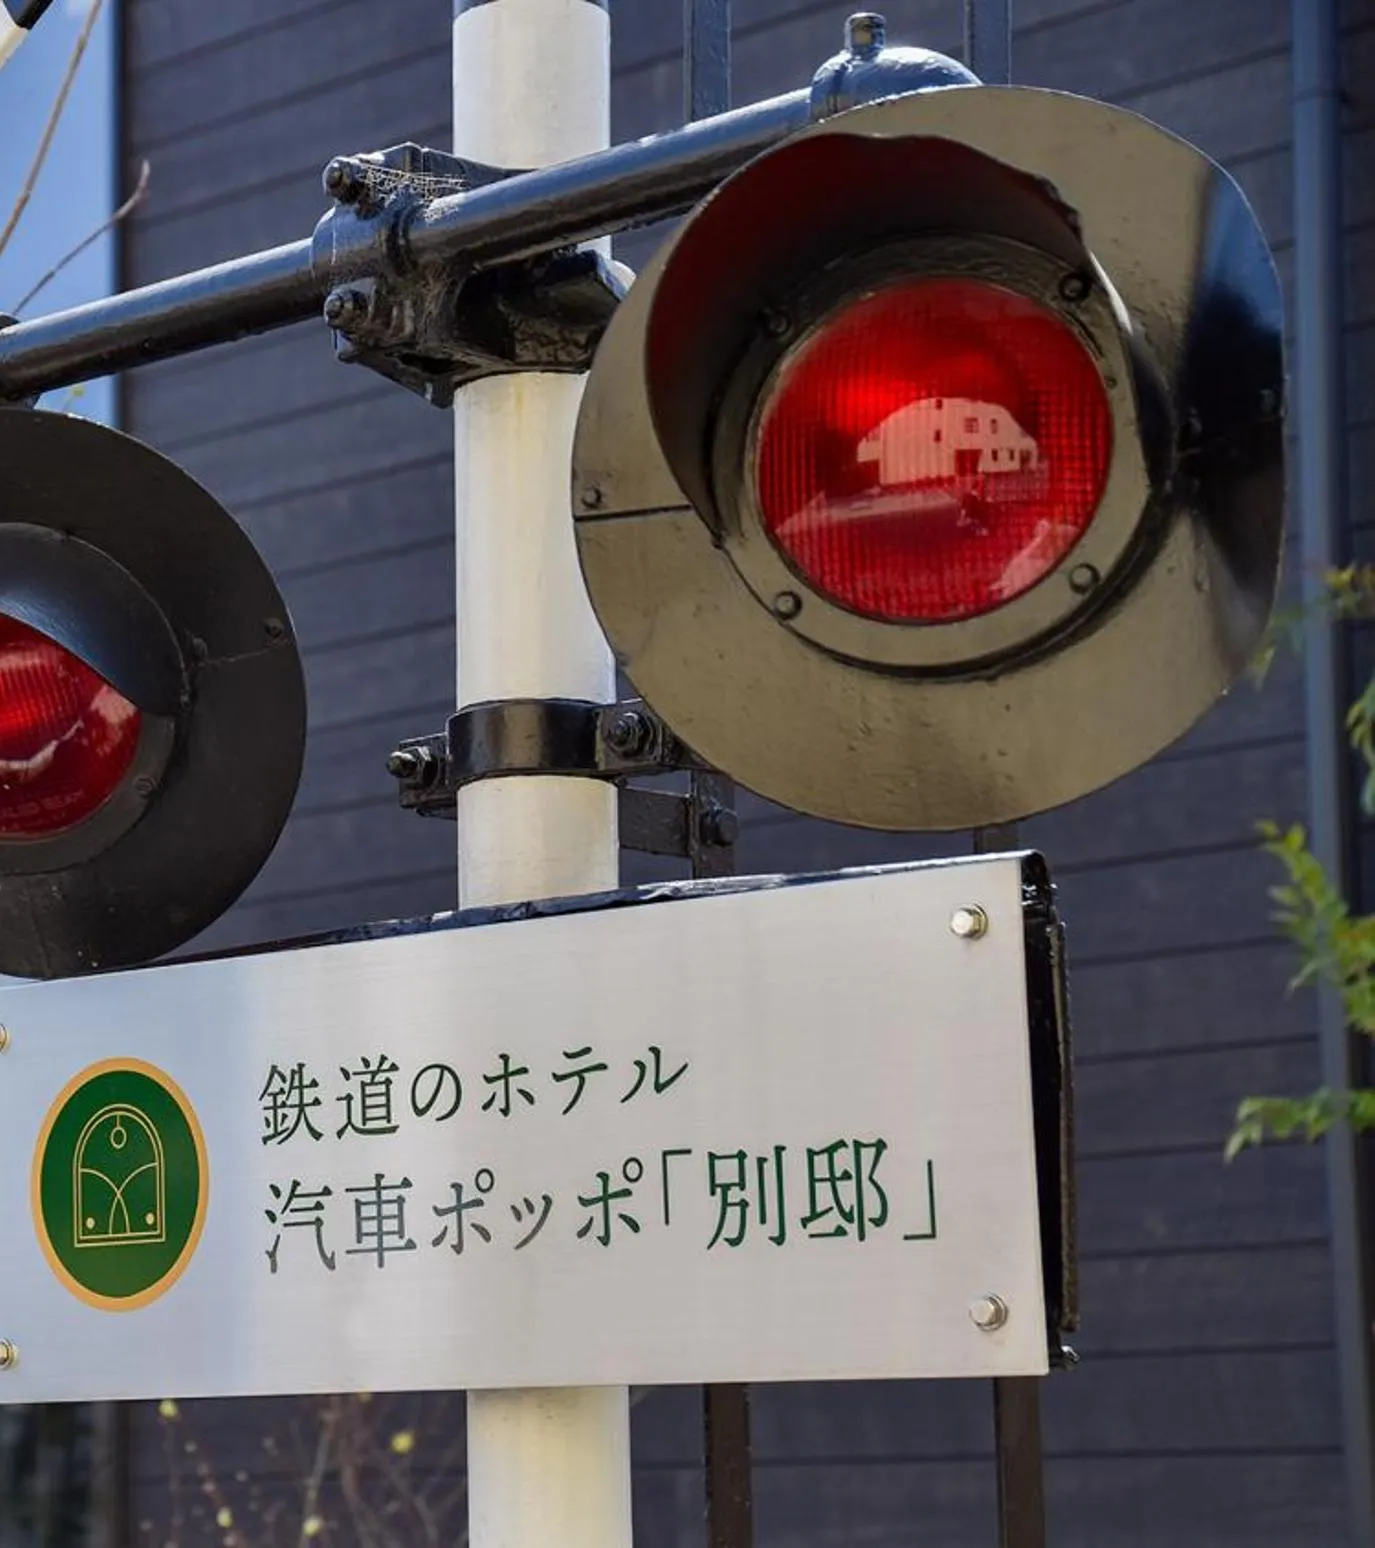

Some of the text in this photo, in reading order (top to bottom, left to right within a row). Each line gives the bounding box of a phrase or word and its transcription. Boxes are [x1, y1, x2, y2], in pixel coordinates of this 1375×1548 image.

[259, 1045, 690, 1146] 鉄道のホテル
[263, 1137, 938, 1275] 汽車ポッポ「別邸」
